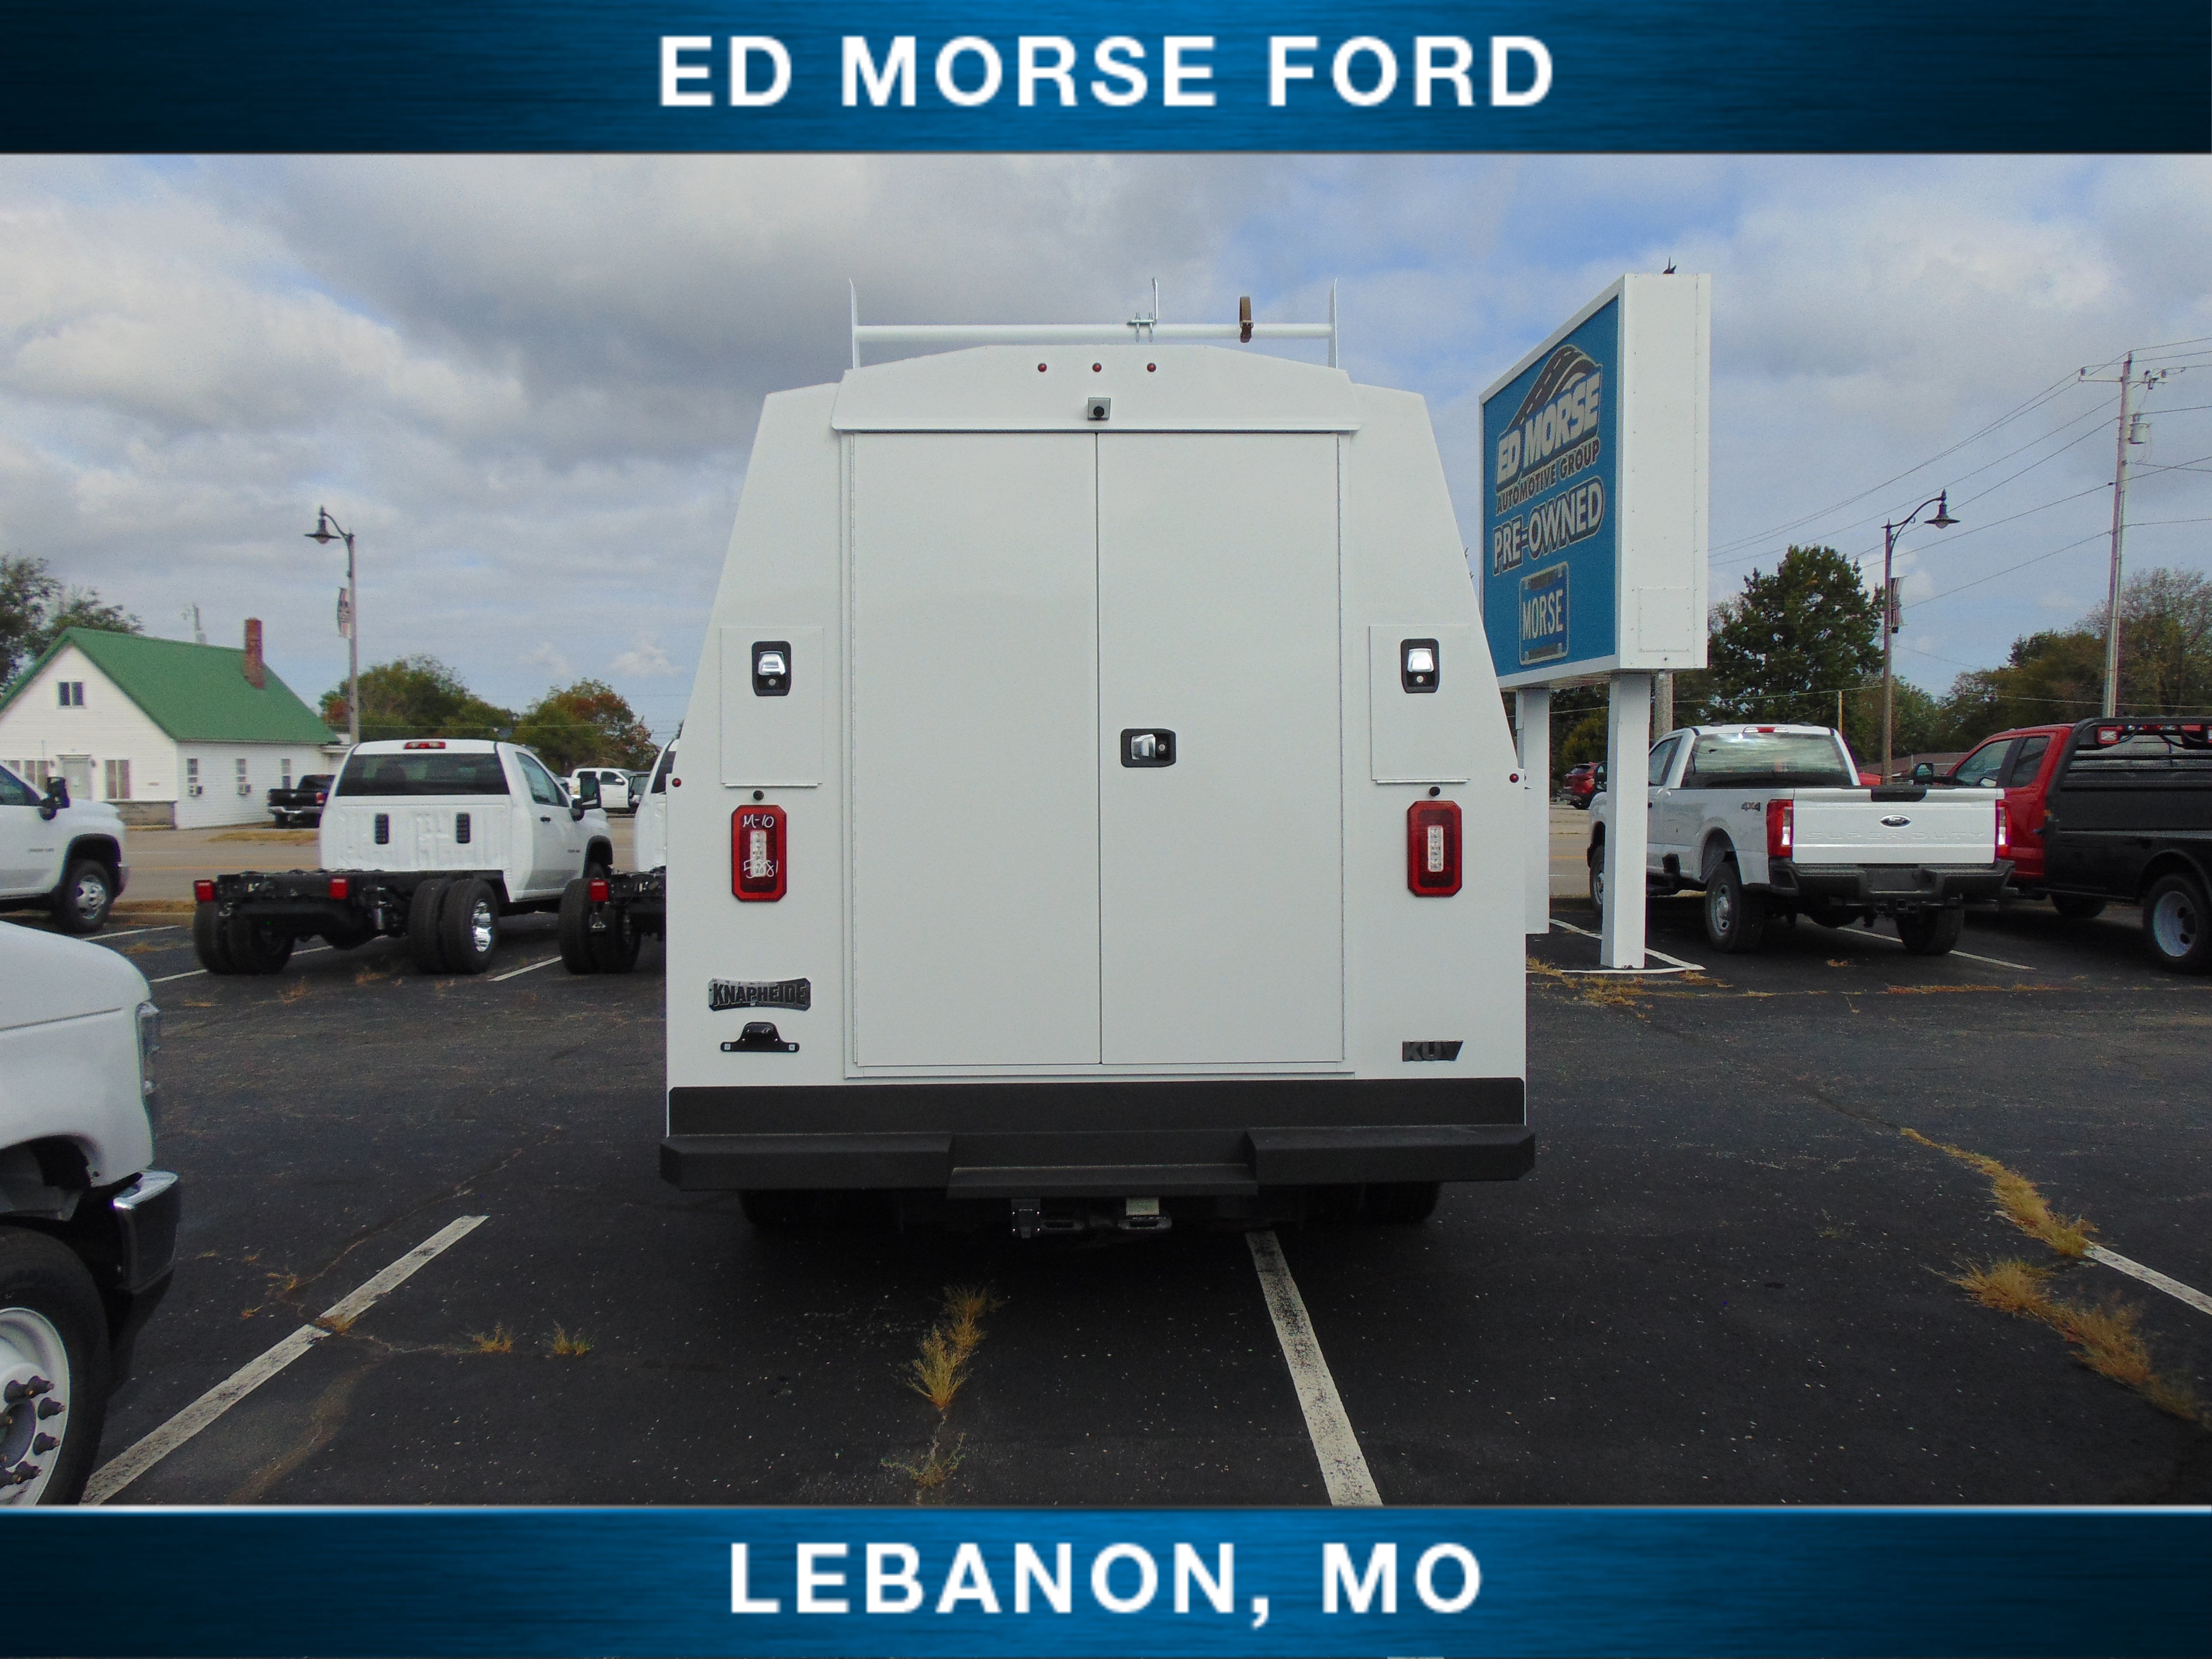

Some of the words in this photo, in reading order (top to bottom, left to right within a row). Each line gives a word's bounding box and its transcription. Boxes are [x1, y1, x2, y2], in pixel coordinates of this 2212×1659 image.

[1497, 429, 1520, 485] ED
[1524, 372, 1601, 469] MORSE
[1497, 461, 1556, 515] AUTOMOTIVE
[1560, 438, 1600, 480] GROUP
[1494, 480, 1604, 572] PRE-OWNED
[1523, 589, 1564, 641] MORSE
[743, 814, 775, 829] M-10
[713, 983, 807, 1006] KNAPHEIDE
